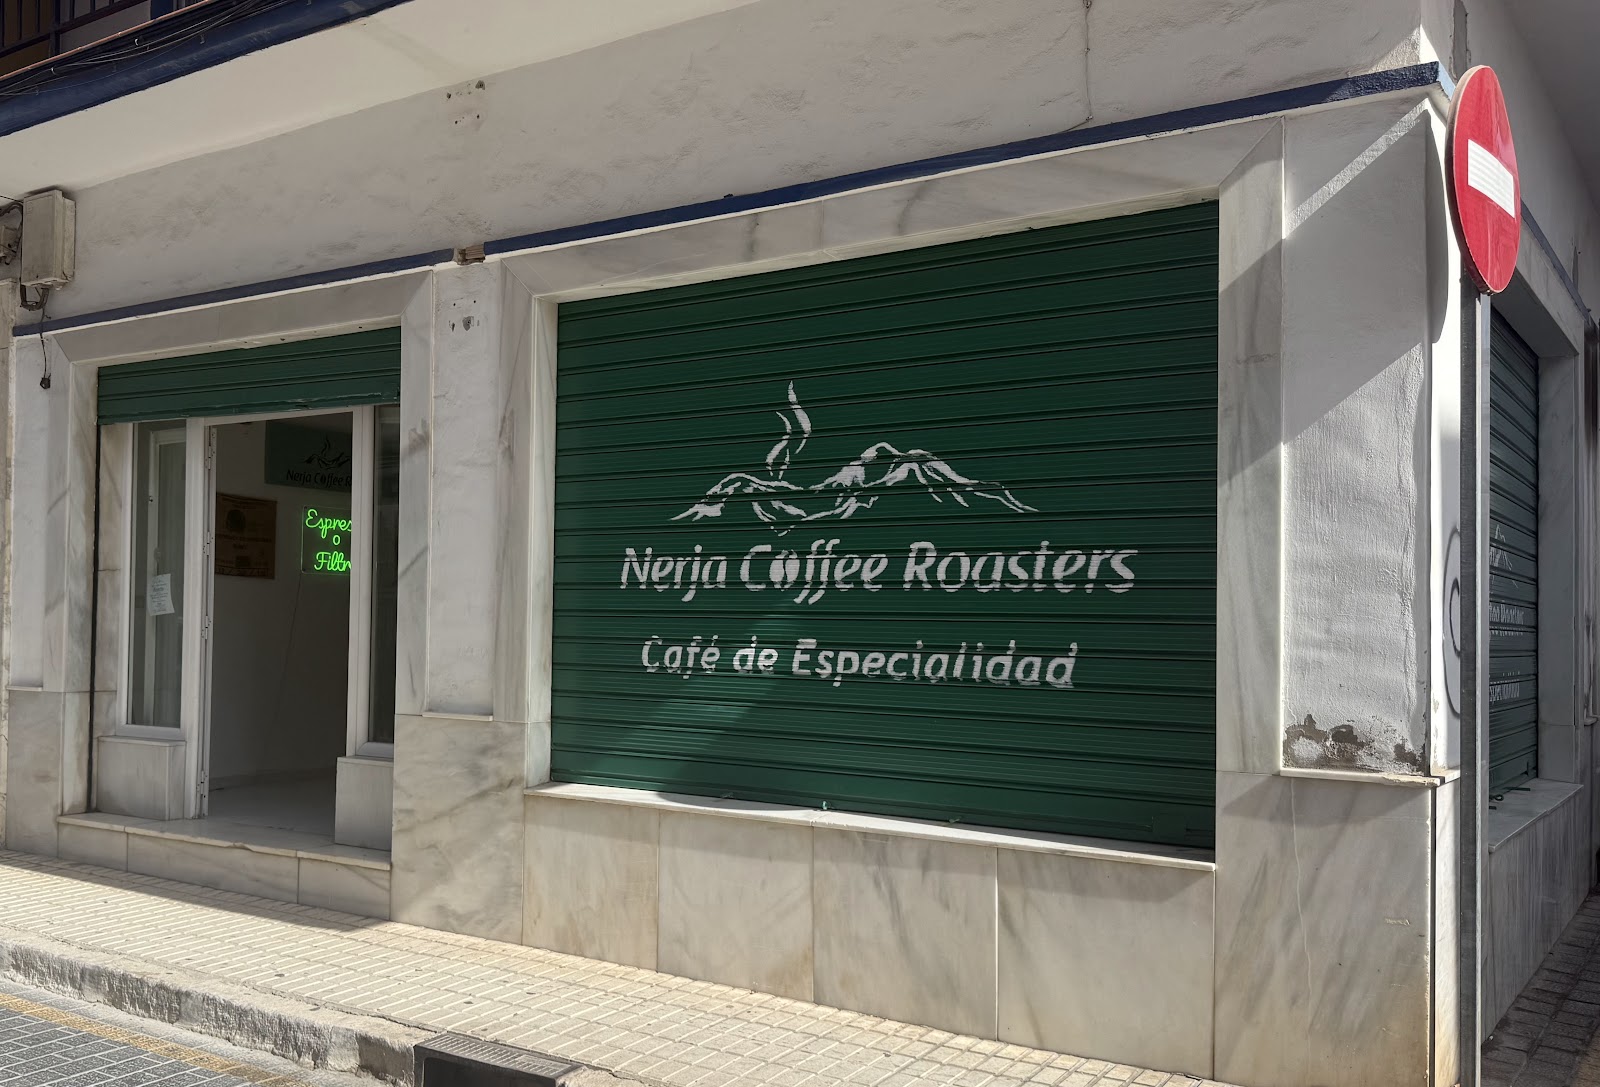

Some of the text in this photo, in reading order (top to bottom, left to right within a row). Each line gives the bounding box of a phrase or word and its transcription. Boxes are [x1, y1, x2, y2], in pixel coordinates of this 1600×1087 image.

[286, 469, 312, 487] Nerja
[314, 472, 344, 489] Coffee
[306, 509, 352, 538] Espres
[314, 551, 352, 572] Filtr
[620, 538, 1139, 605] Nerja Coffee Roasters
[641, 634, 1078, 689] Café de Especialidad
